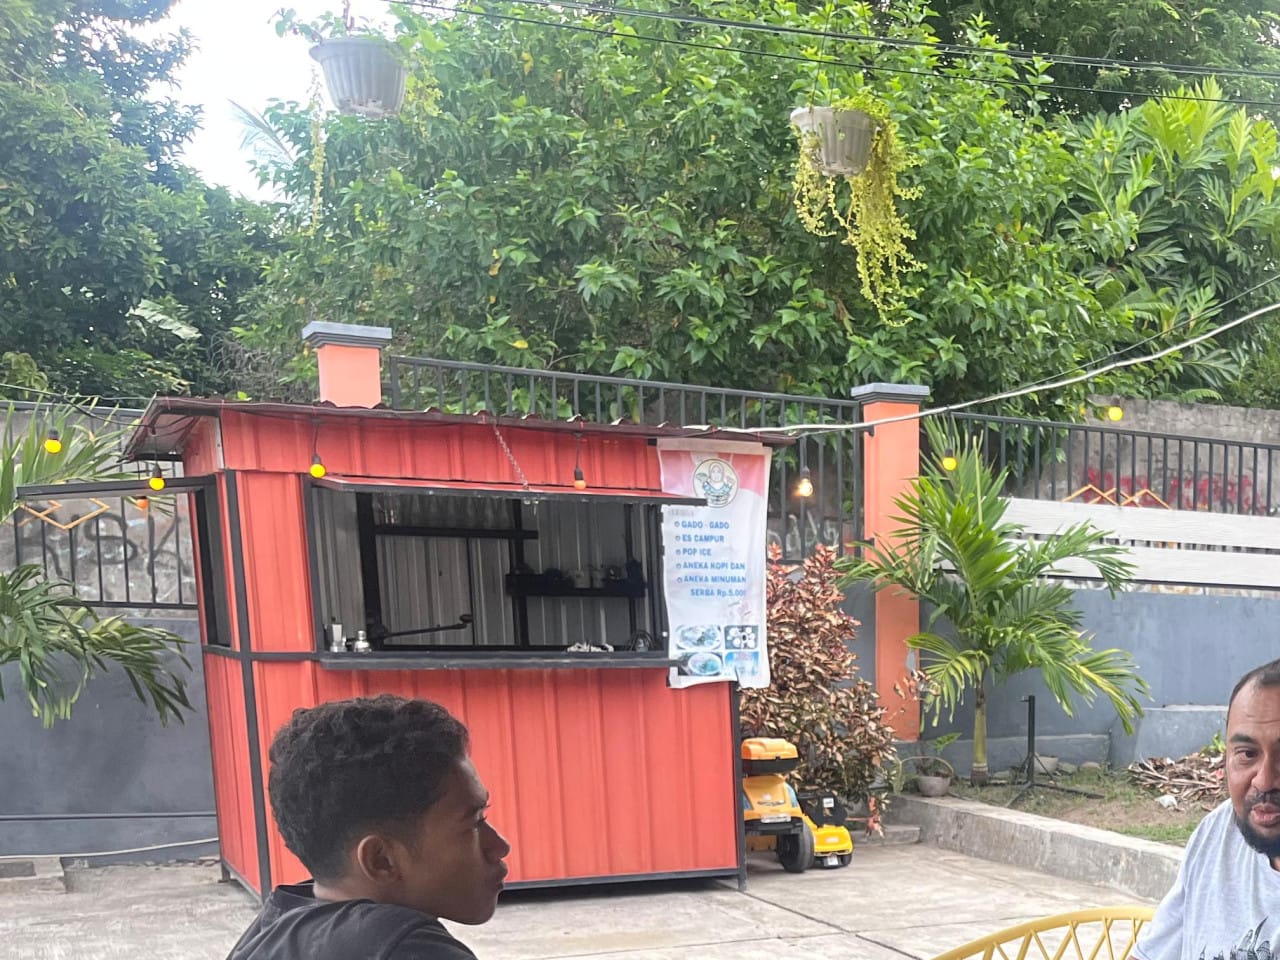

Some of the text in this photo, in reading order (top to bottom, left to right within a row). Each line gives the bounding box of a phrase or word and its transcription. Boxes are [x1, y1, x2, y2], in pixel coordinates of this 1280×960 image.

[681, 521, 703, 529] GADO
[709, 521, 730, 529] GADO
[682, 534, 725, 542] ES CAMPUR
[699, 548, 712, 556] ICE
[730, 562, 746, 570] DAN
[684, 575, 747, 583] ANEKA MINUMAN
[690, 588, 715, 596] SERBA
